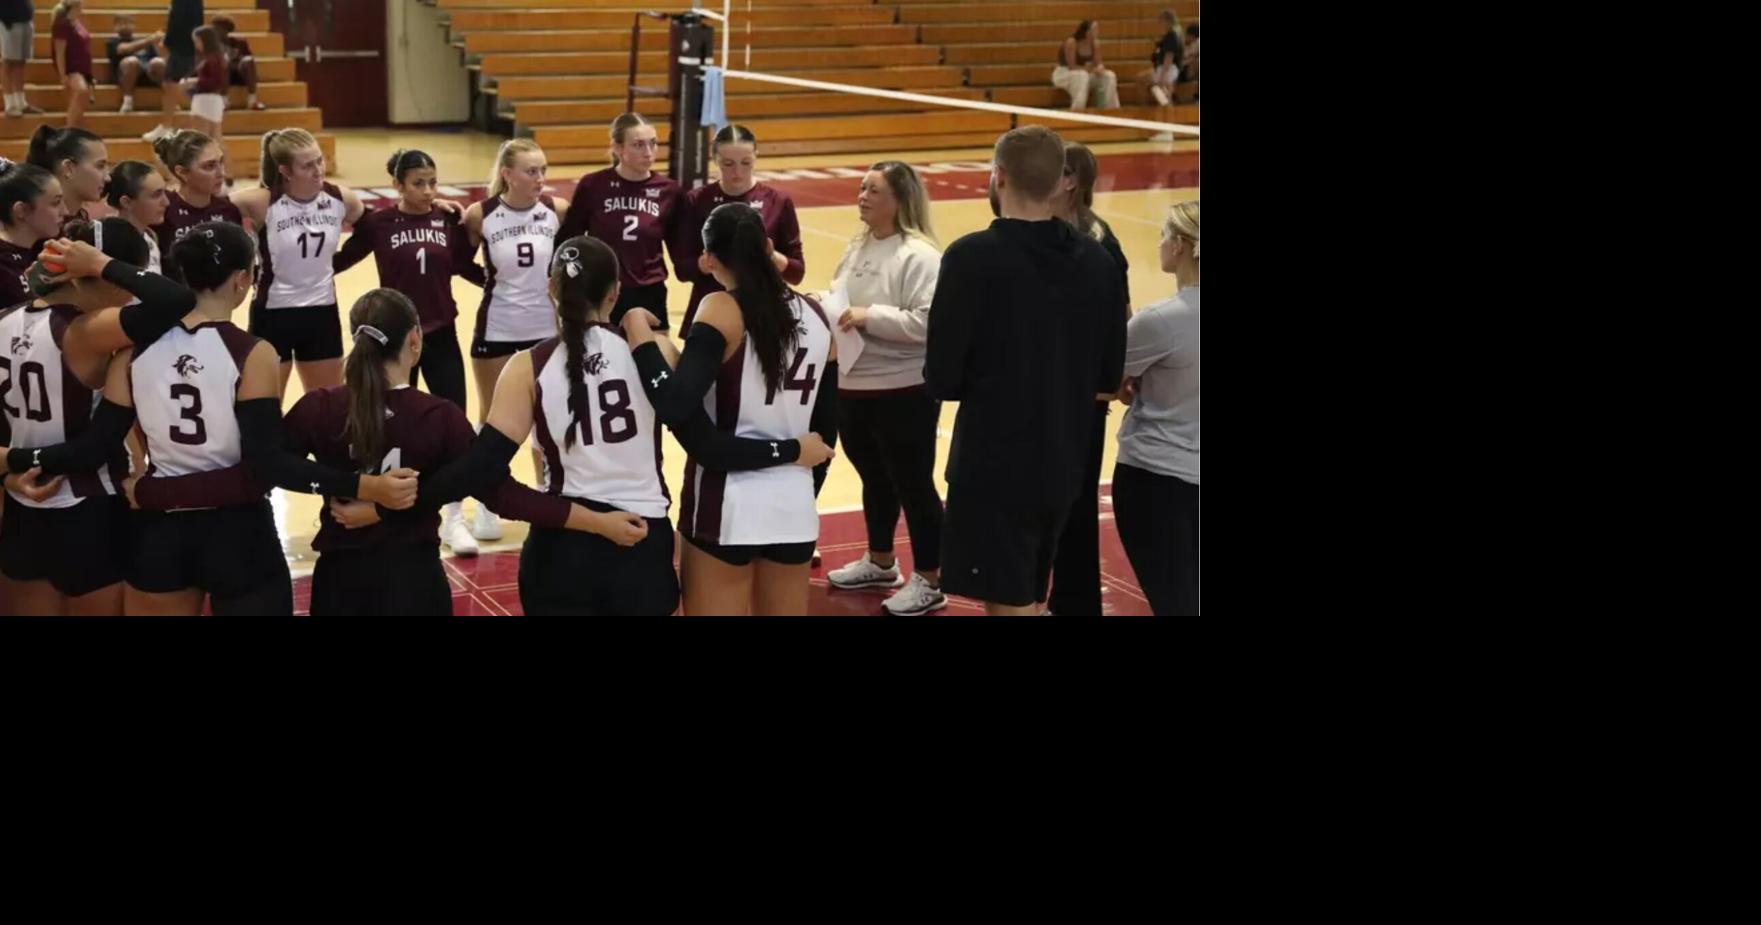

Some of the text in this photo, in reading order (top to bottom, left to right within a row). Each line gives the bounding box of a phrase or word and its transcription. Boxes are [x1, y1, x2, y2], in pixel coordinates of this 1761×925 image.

[604, 196, 660, 217] SALUKIS
[390, 228, 447, 249] SALUKIS
[622, 215, 639, 241] 2
[297, 231, 326, 259] 17
[516, 242, 535, 268] 9
[416, 247, 426, 275] 1
[0, 355, 52, 423] 20
[169, 383, 207, 446] 3
[567, 378, 638, 447] 18
